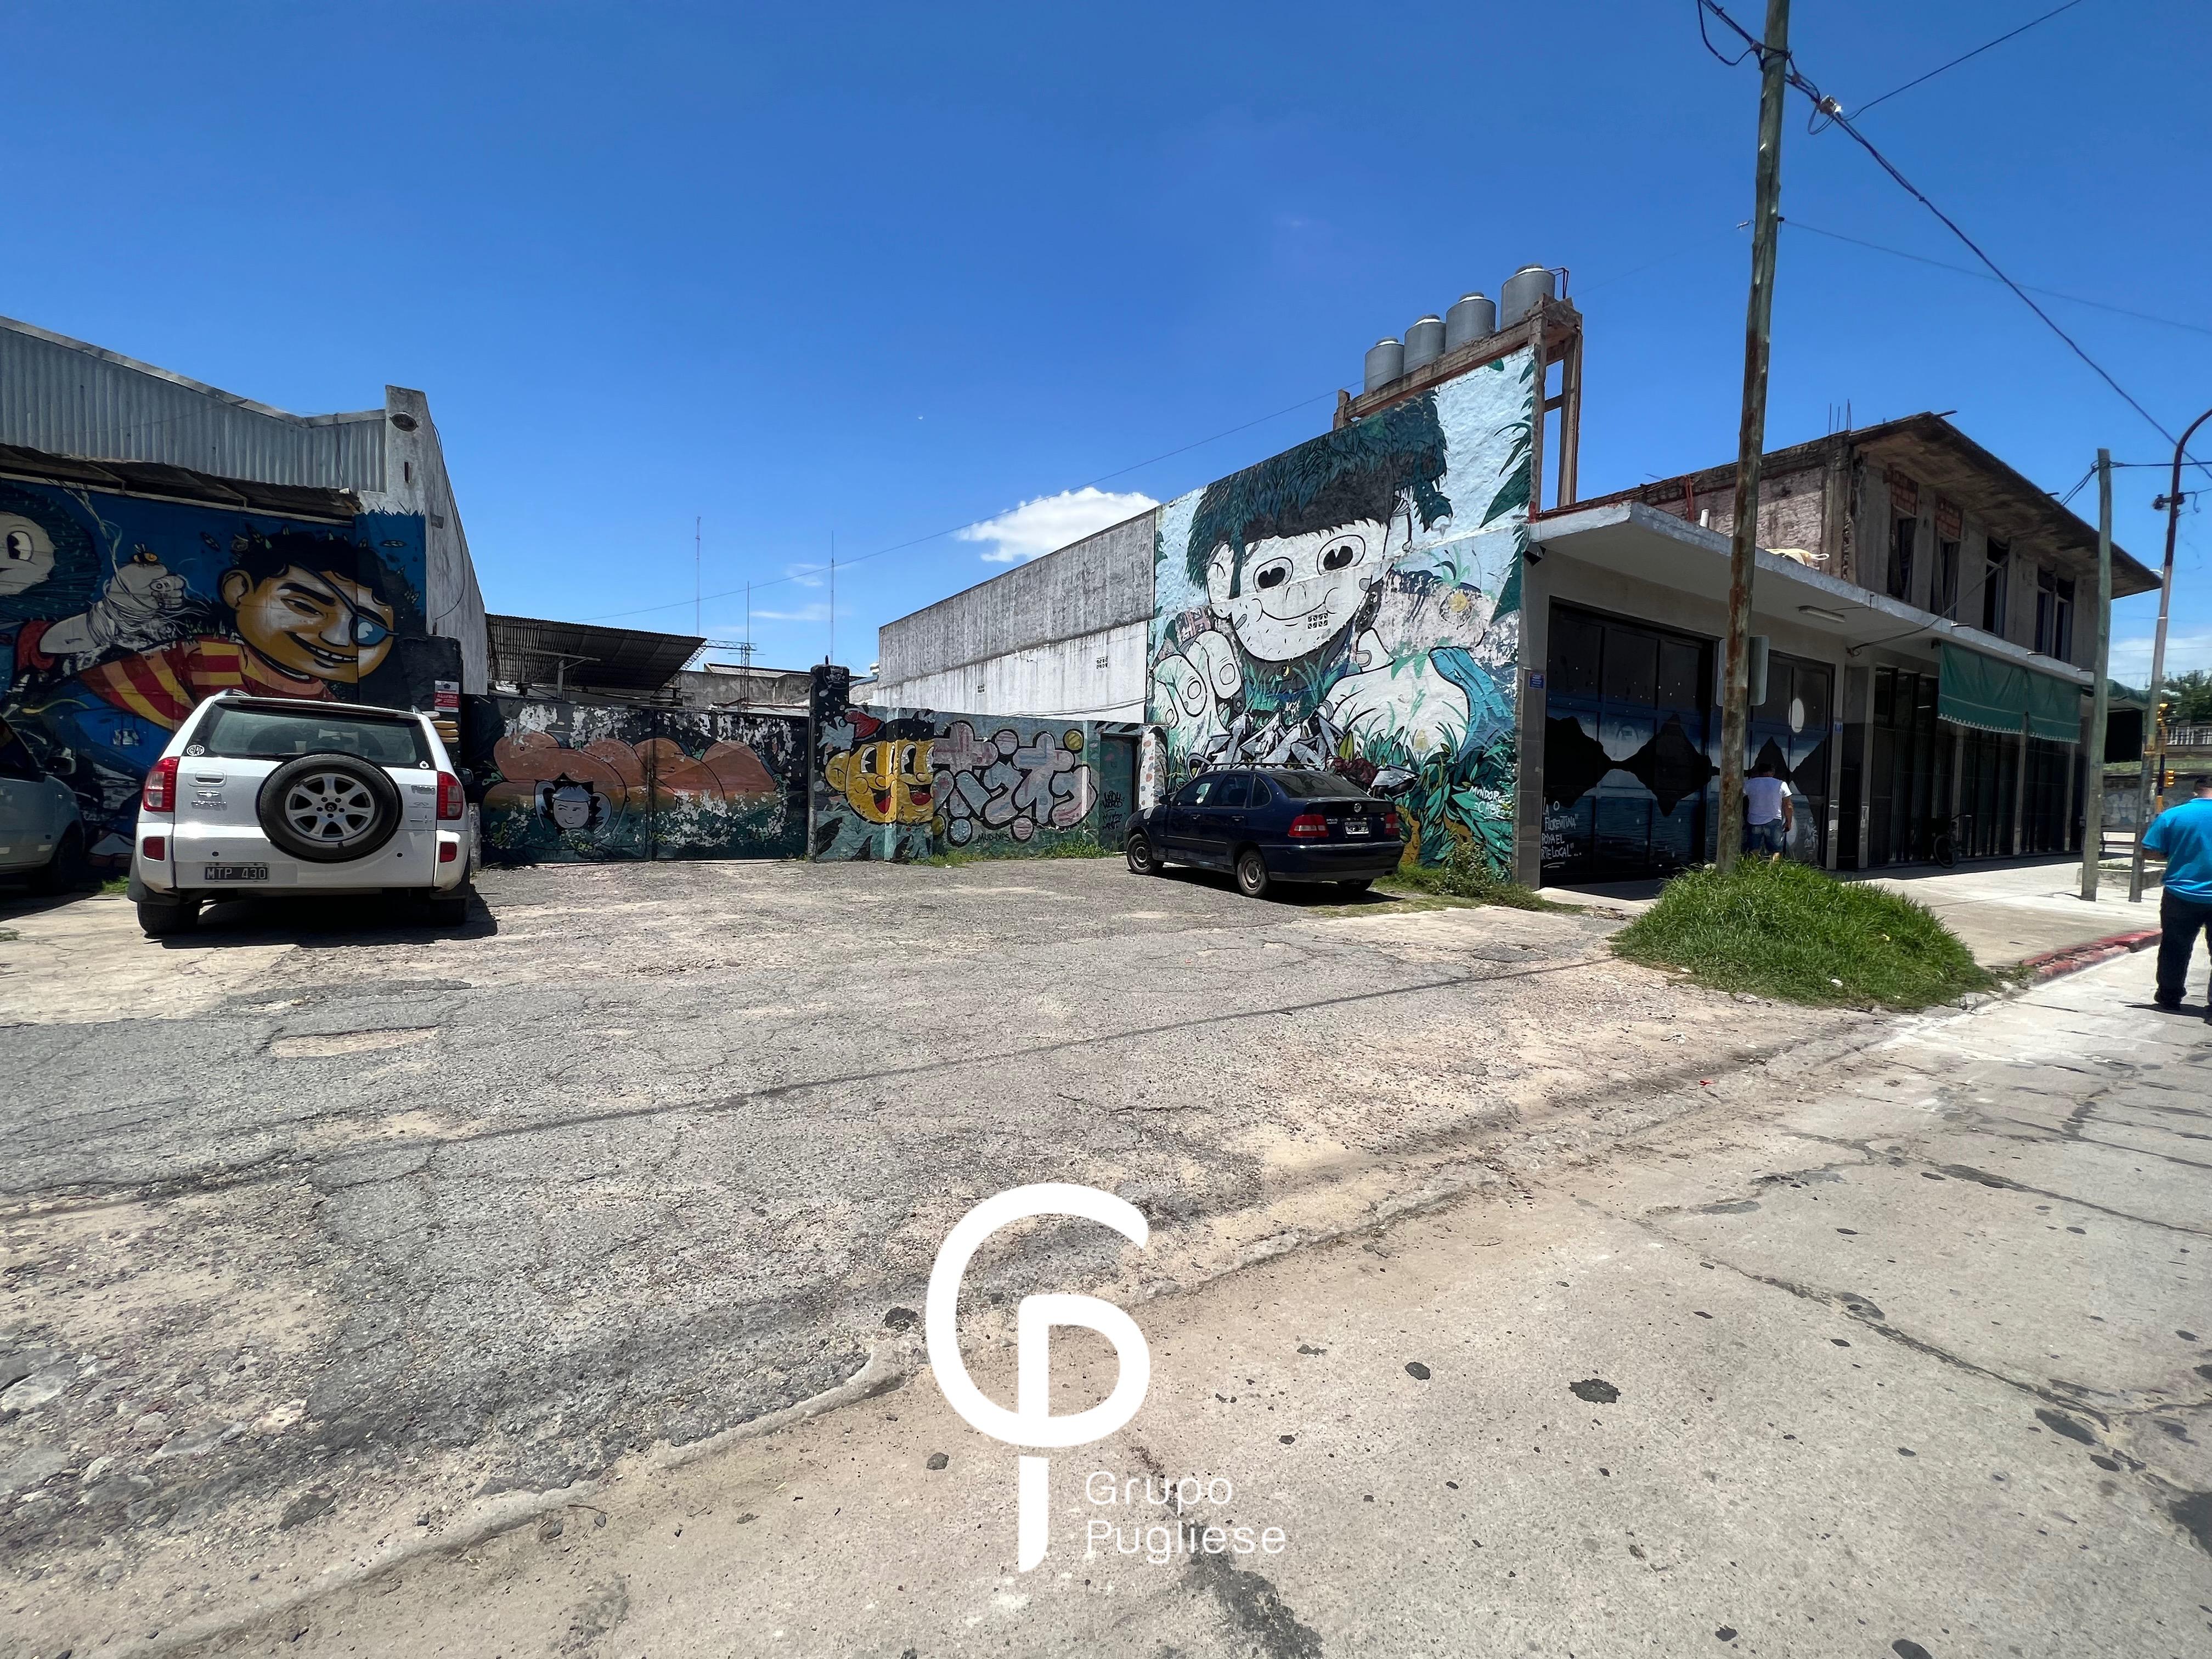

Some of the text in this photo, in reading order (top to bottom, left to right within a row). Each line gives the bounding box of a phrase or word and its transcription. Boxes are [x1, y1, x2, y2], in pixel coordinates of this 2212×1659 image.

[1541, 832, 1555, 845] POYA
[1541, 846, 1552, 860] RTE
[207, 868, 266, 879] MTP 430
